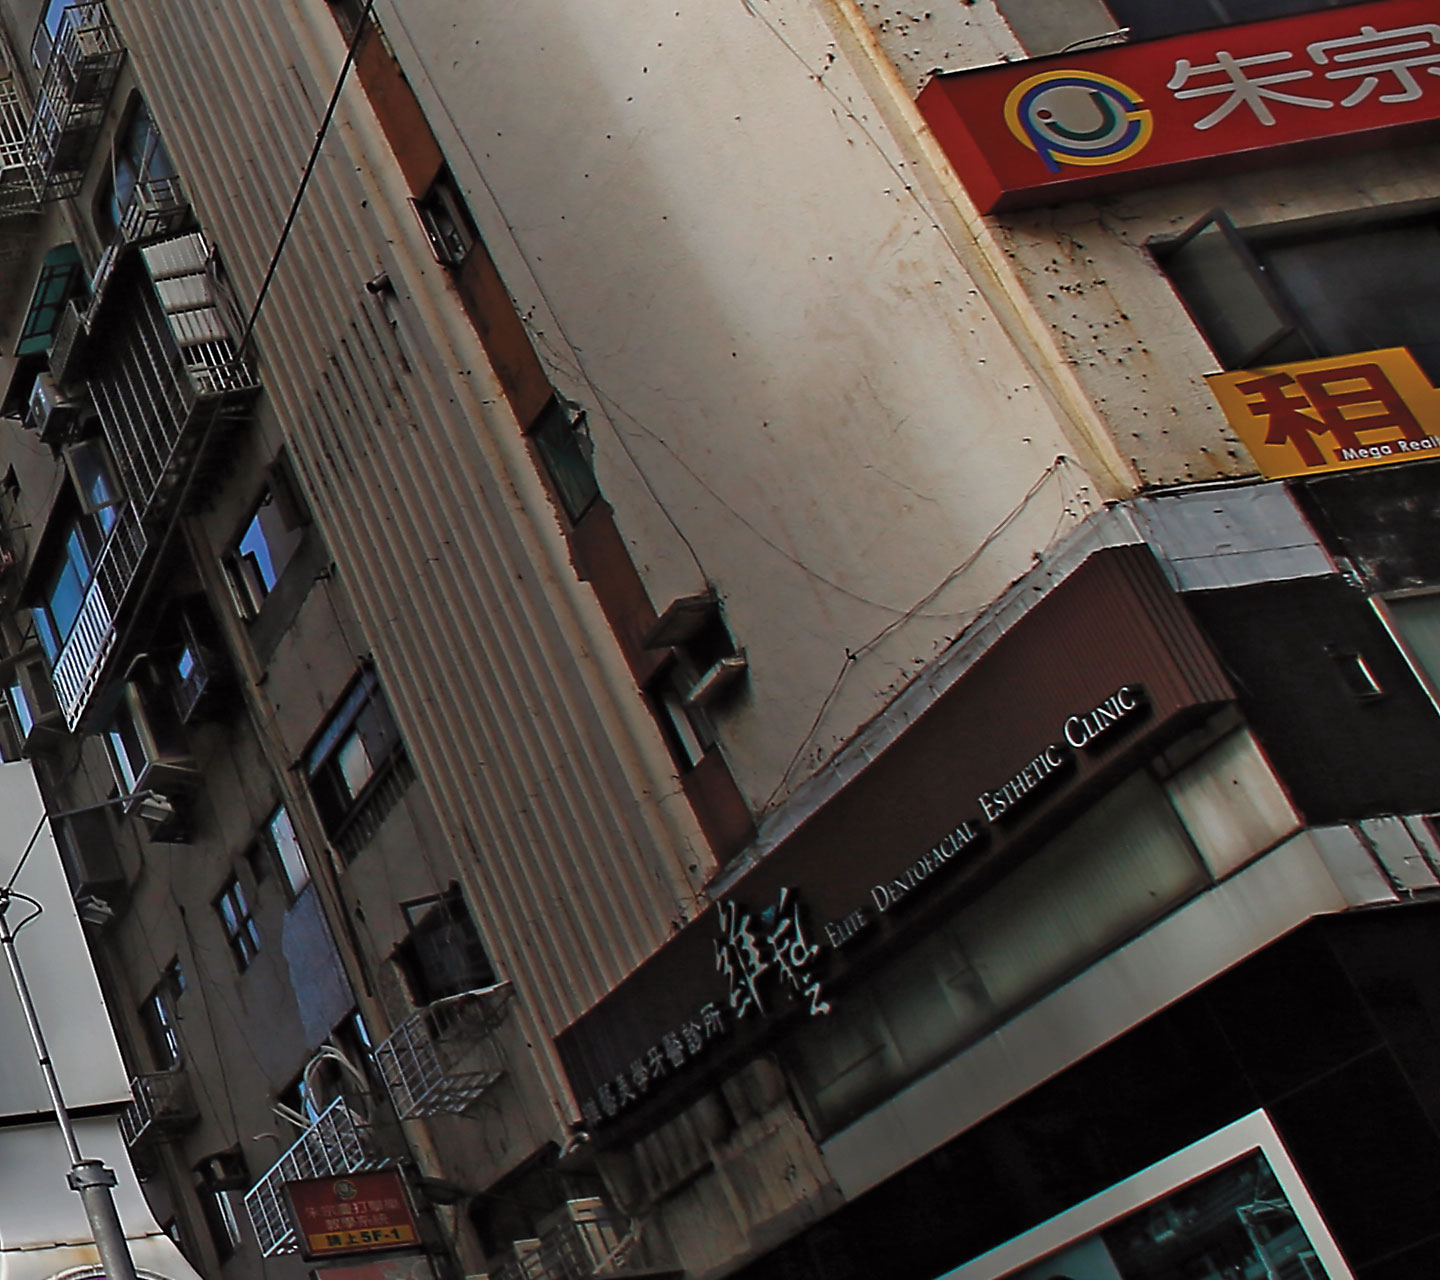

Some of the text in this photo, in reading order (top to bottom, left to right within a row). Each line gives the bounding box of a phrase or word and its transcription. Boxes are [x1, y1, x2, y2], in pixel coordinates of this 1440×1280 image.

[1234, 361, 1429, 469] 租
[1341, 443, 1391, 463] Mega
[1063, 684, 1137, 750] CLINIC
[977, 742, 1065, 824] ESTHETIC
